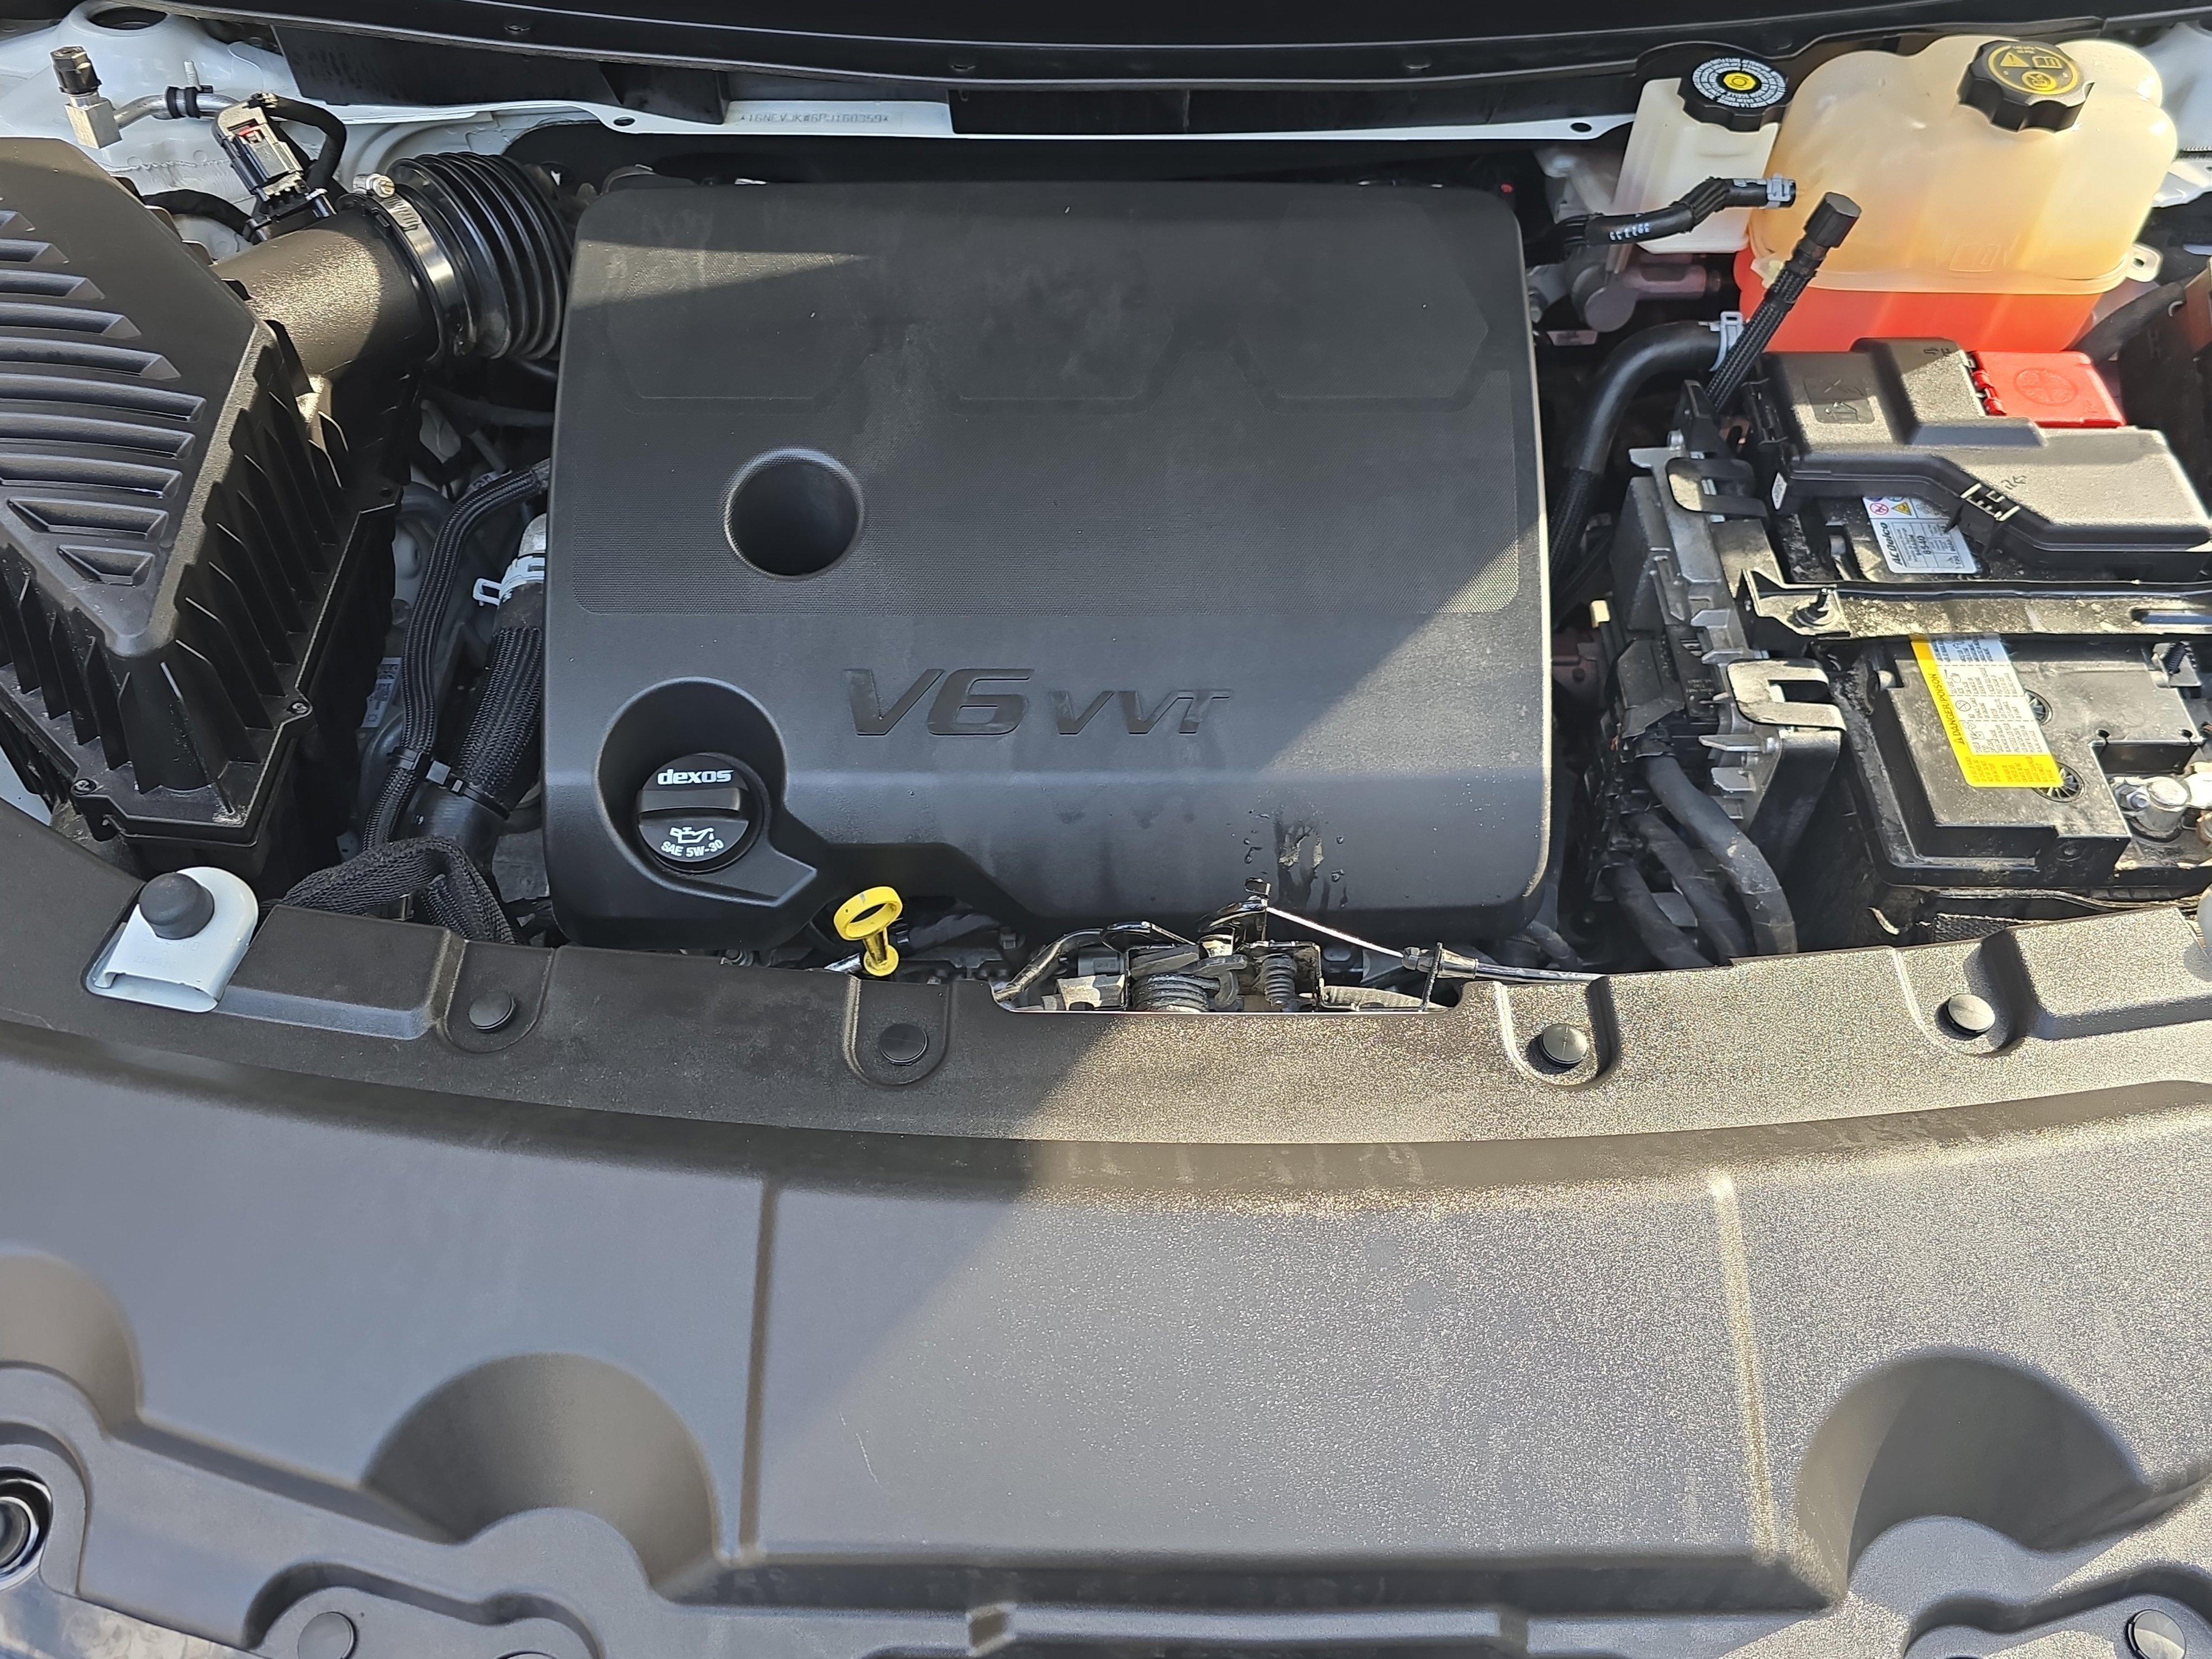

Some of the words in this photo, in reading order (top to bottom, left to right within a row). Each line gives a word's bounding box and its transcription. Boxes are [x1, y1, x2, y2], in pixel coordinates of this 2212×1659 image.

[1880, 522, 1902, 566] ACDelco
[843, 668, 1034, 736] V6
[1048, 688, 1233, 735] VVT
[1928, 673, 1961, 740] DANGER/POISON
[657, 769, 734, 785] dexos
[660, 840, 684, 857] SAE
[685, 839, 724, 857] 5W-30
